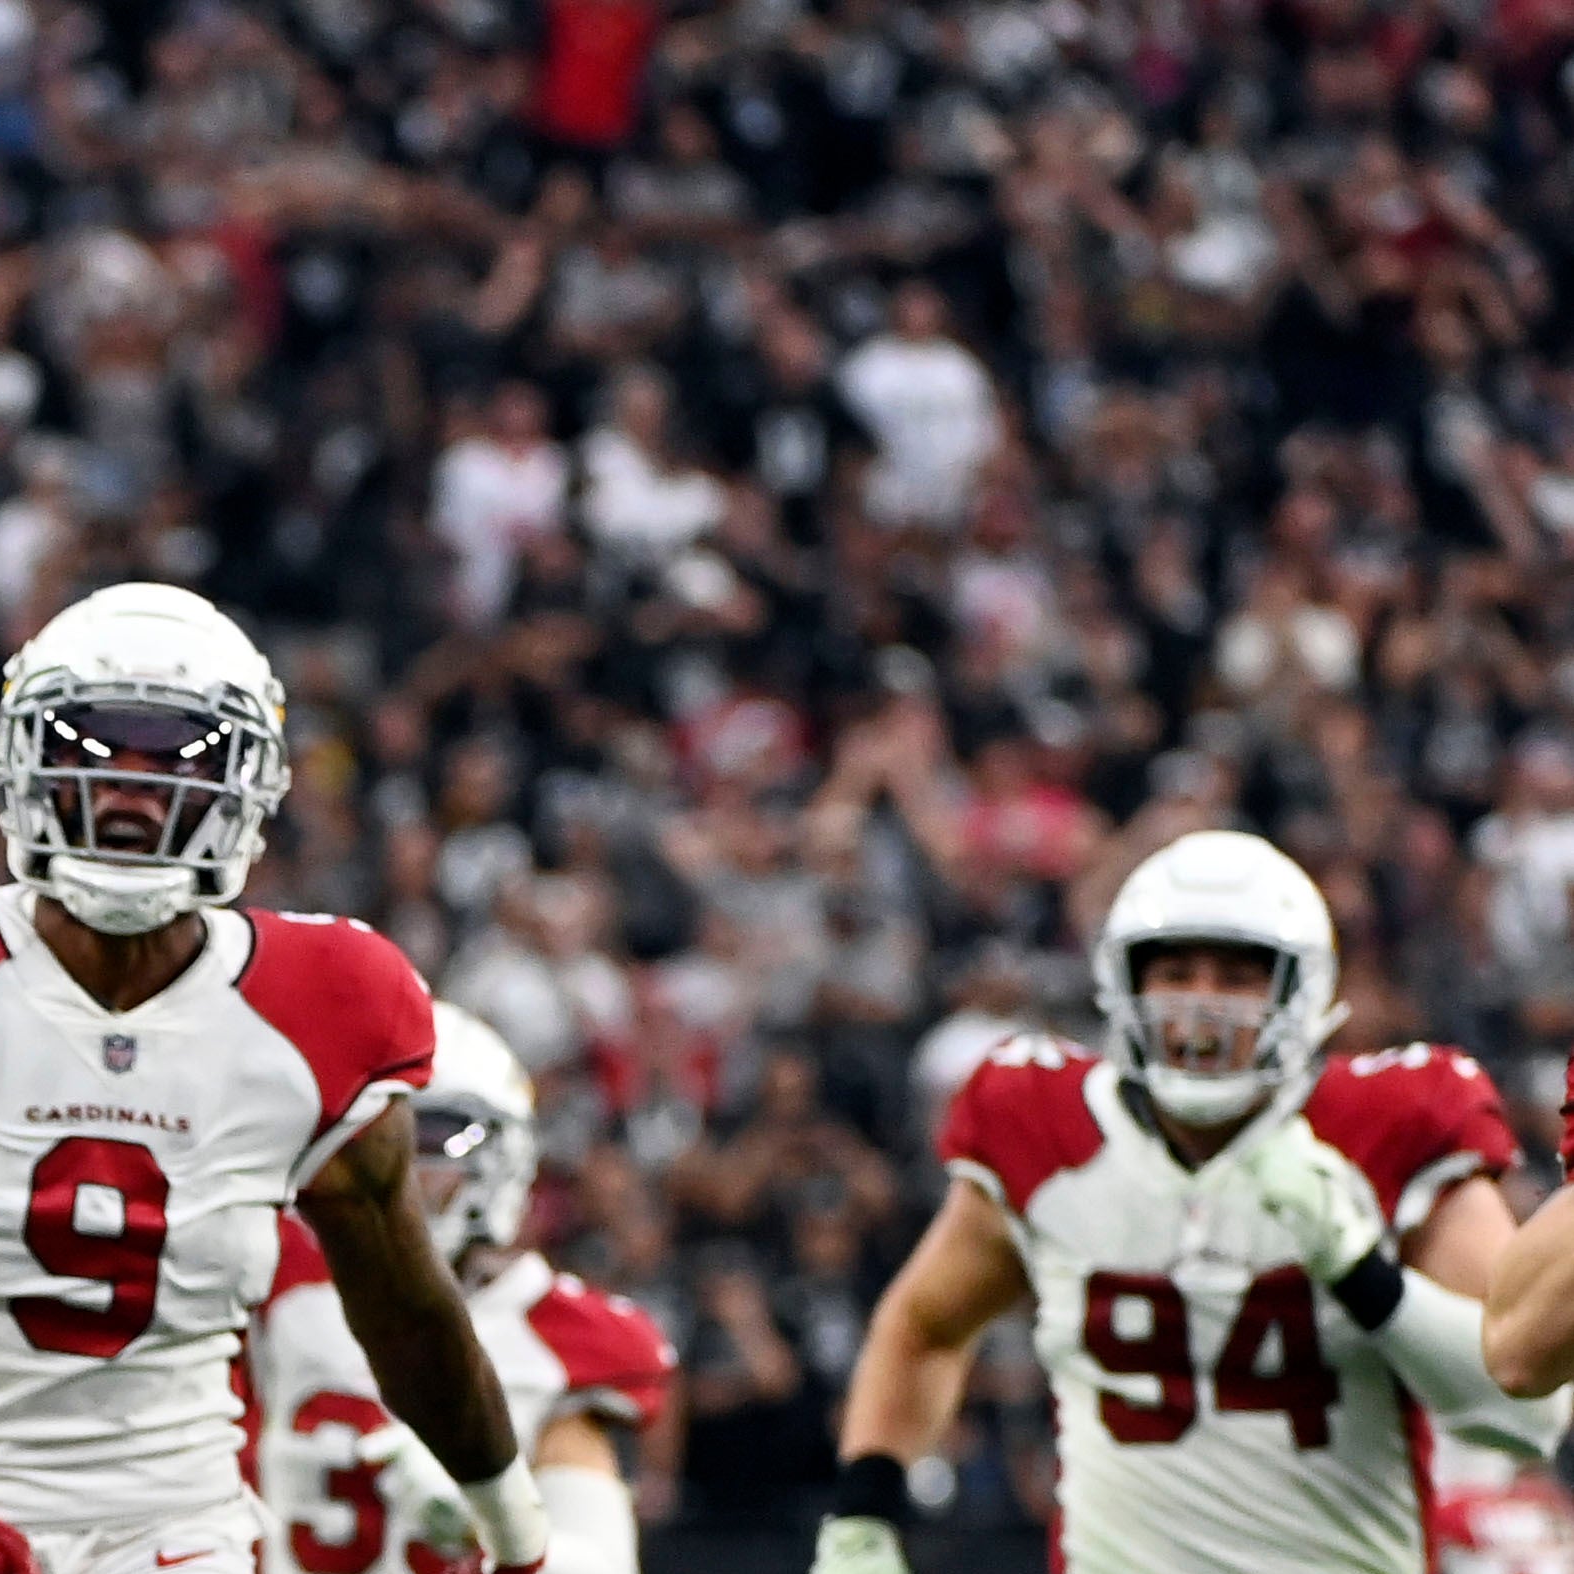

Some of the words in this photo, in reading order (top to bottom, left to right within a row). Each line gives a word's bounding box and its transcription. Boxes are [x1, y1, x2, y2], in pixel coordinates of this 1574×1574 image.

[24, 1103, 191, 1133] CARDINALS
[7, 1135, 170, 1361] 9
[1083, 1262, 1339, 1450] 94
